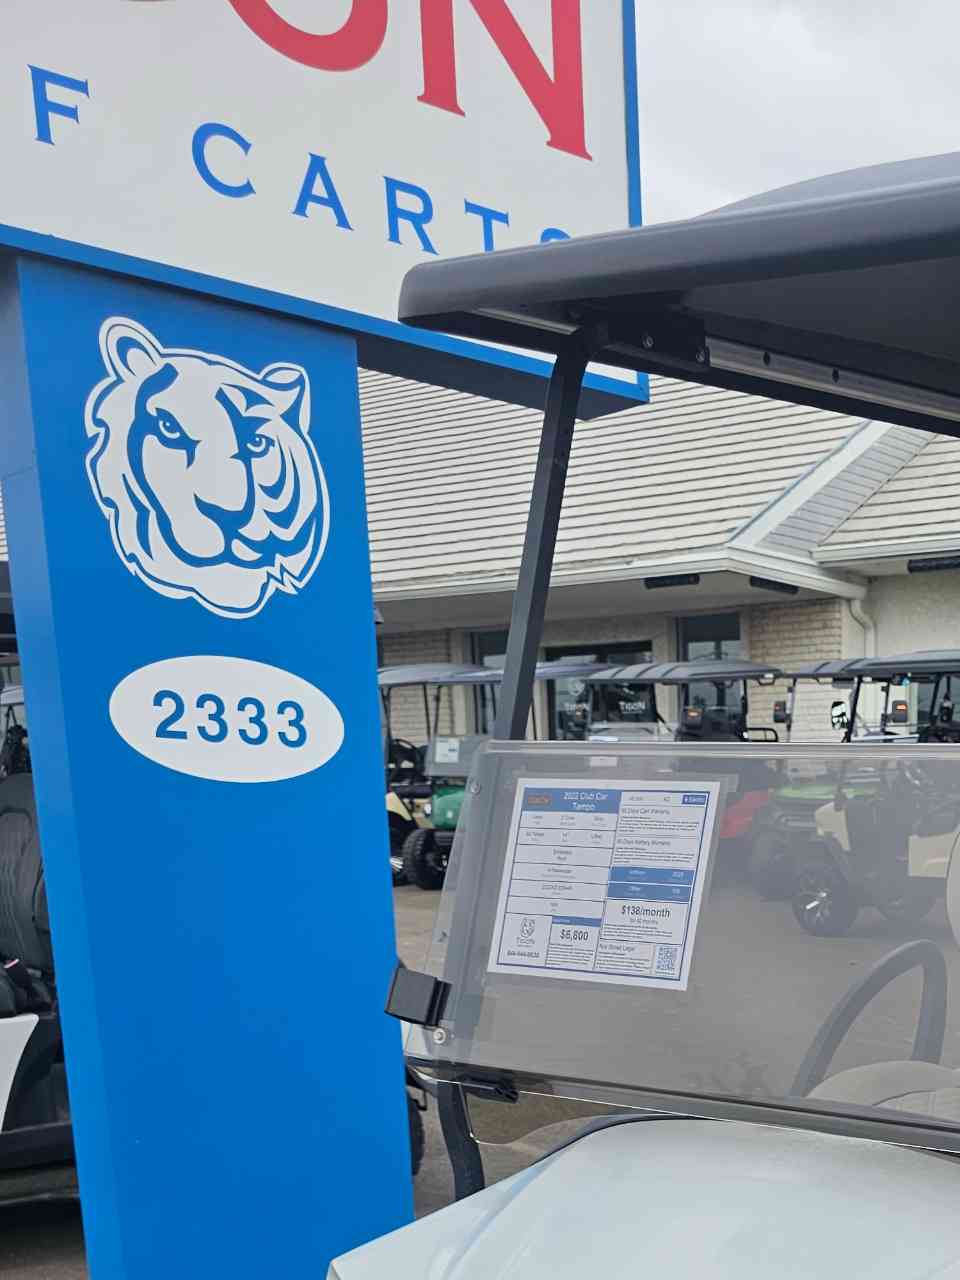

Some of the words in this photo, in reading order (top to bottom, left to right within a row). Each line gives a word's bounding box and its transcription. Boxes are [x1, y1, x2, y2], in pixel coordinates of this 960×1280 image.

[191, 122, 571, 255] CART
[152, 689, 308, 748] 2333
[621, 904, 670, 918] $138/month
